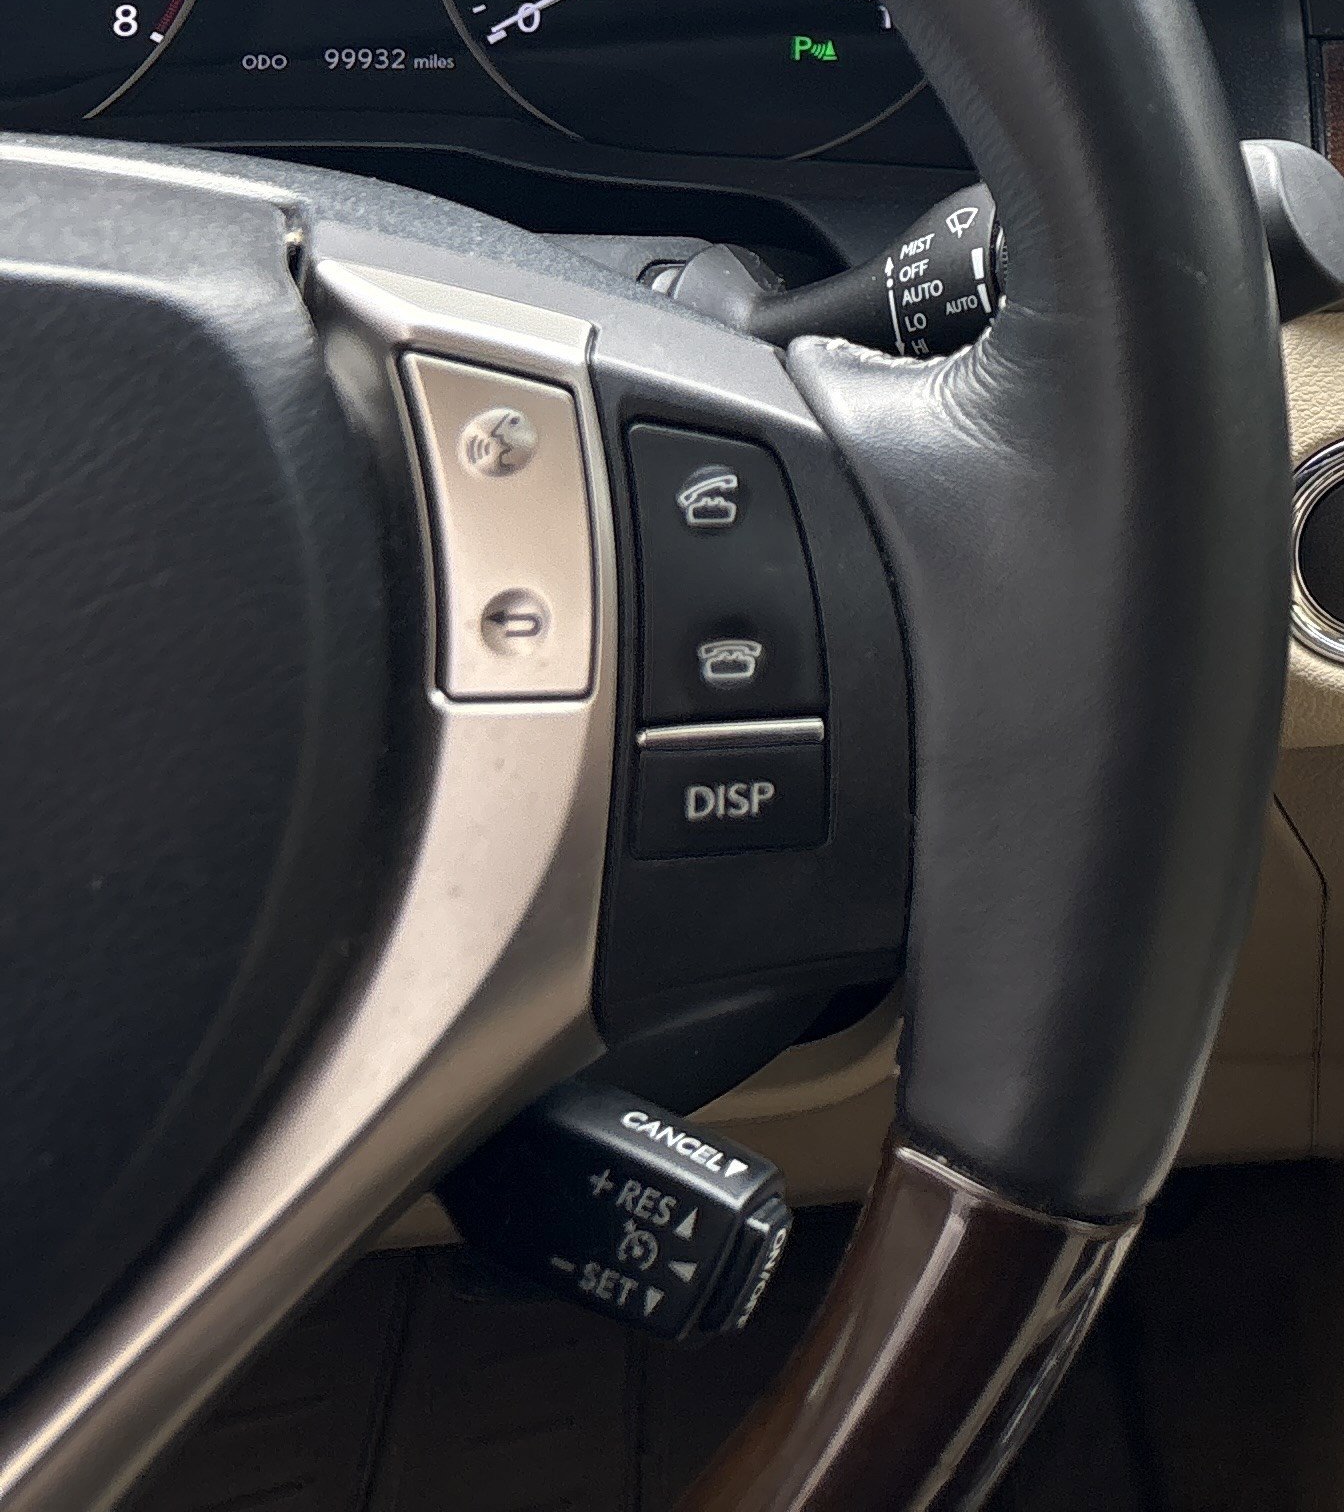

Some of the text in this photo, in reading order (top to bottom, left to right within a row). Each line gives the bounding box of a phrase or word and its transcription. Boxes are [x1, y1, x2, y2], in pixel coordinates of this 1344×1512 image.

[112, 4, 138, 37] 8
[517, 2, 541, 33] 0
[241, 54, 288, 70] ODO
[324, 48, 455, 70] 99932 miles
[900, 233, 935, 260] MIST
[899, 258, 929, 282] OFF
[902, 279, 943, 307] AUTO
[945, 294, 978, 316] AUTO
[904, 312, 927, 333] LO
[911, 338, 930, 355] HI
[685, 781, 775, 822] DISP
[620, 1111, 725, 1172] CANCEL
